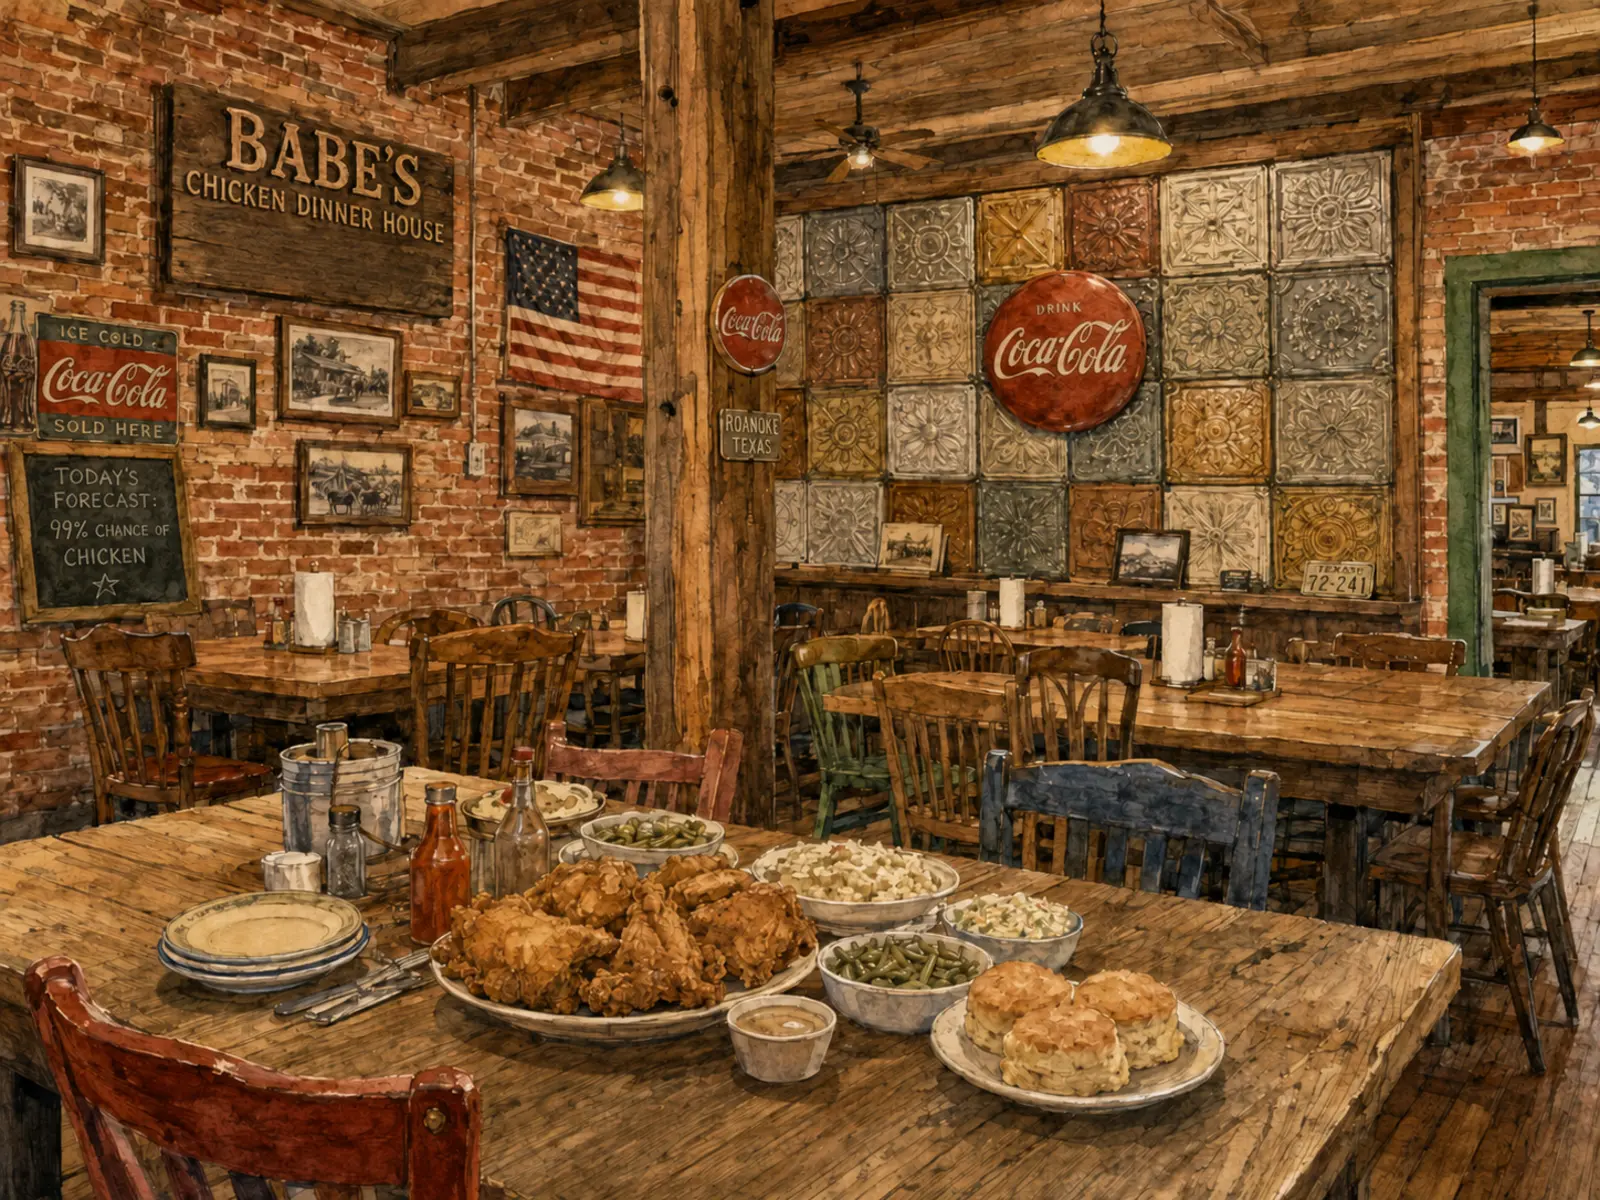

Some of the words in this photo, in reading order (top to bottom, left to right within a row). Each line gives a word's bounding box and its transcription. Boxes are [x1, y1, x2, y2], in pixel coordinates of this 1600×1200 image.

[226, 106, 421, 207] BABE'S
[186, 169, 285, 213] CHICKEN
[297, 193, 373, 231] DINNER
[383, 210, 445, 243] HOUSE
[1036, 301, 1082, 316] DRINK
[721, 306, 784, 343] Coca-Cola
[60, 325, 89, 341] ICE
[99, 330, 143, 347] COLD
[993, 318, 1134, 380] Coca-Cola
[42, 357, 172, 409] Coca-Cola
[54, 419, 105, 434] SOLD
[116, 422, 163, 439] HERE
[725, 413, 780, 436] ROANOKE
[732, 436, 772, 455] TEXAS
[54, 467, 139, 486] TODAY'S
[54, 492, 157, 509] FORECAST:
[50, 519, 89, 540] 99%
[95, 524, 148, 538] CHANCE
[155, 524, 170, 536] OF
[64, 547, 146, 566] CHICKEN
[1309, 575, 1366, 594] 72-241
